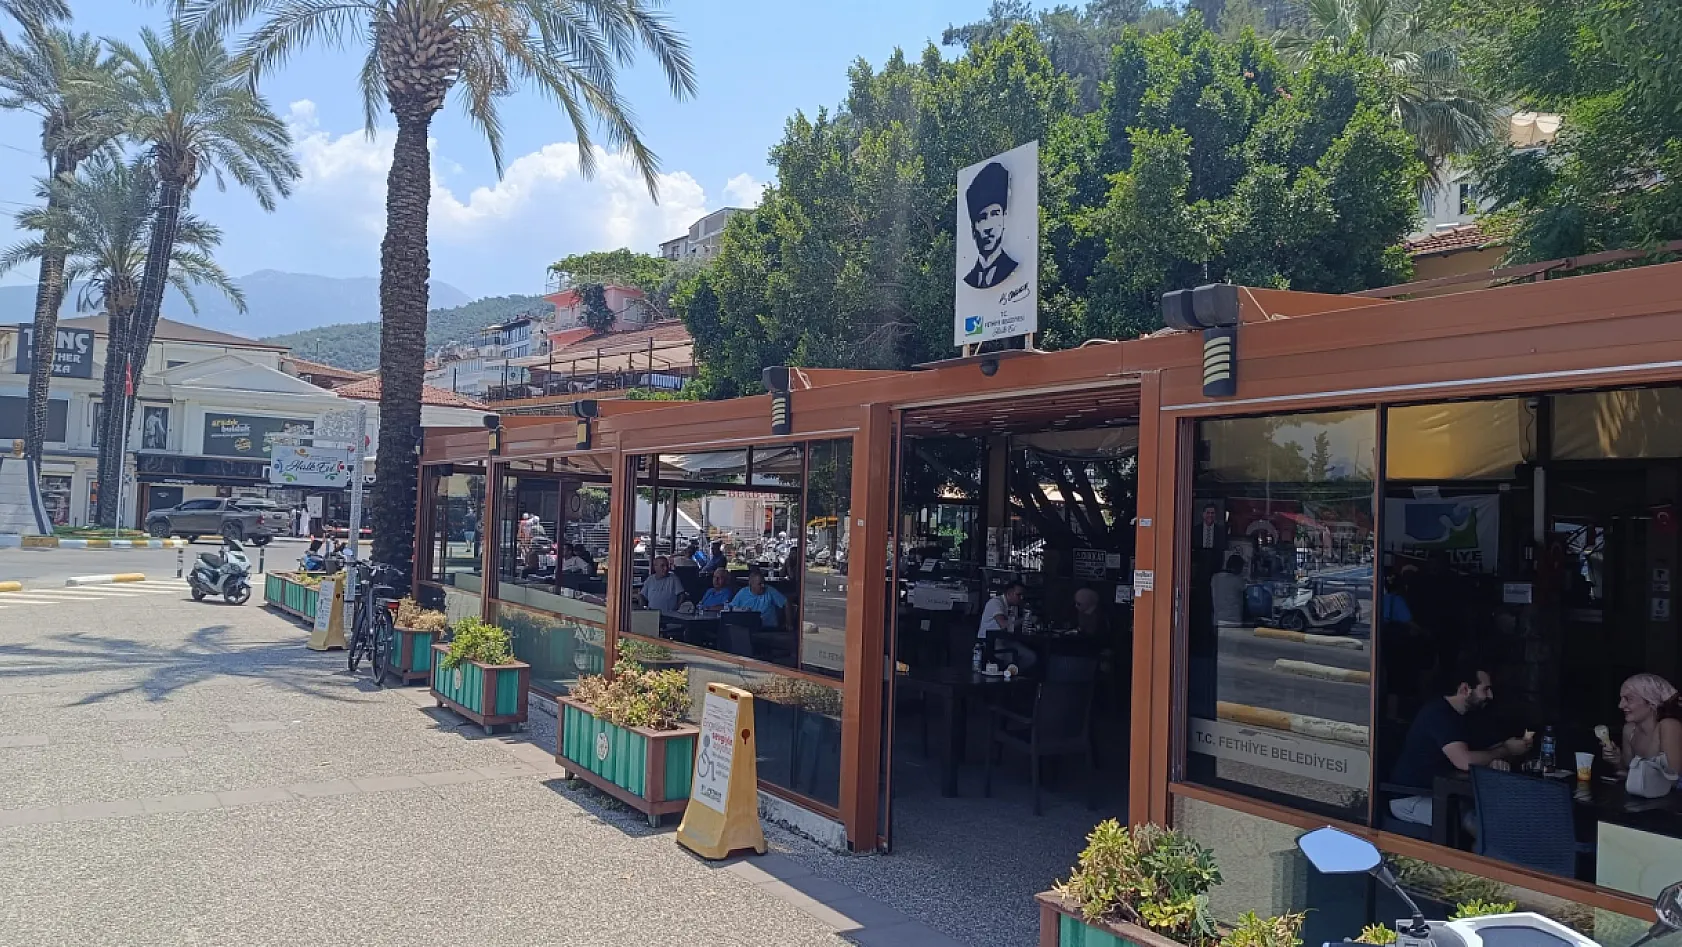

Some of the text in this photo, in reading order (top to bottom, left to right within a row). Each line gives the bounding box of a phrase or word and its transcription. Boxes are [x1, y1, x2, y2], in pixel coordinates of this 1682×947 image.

[23, 328, 90, 354] TNÇ
[1196, 731, 1348, 774] T.C. FETHİYE BELEDİYESİ
